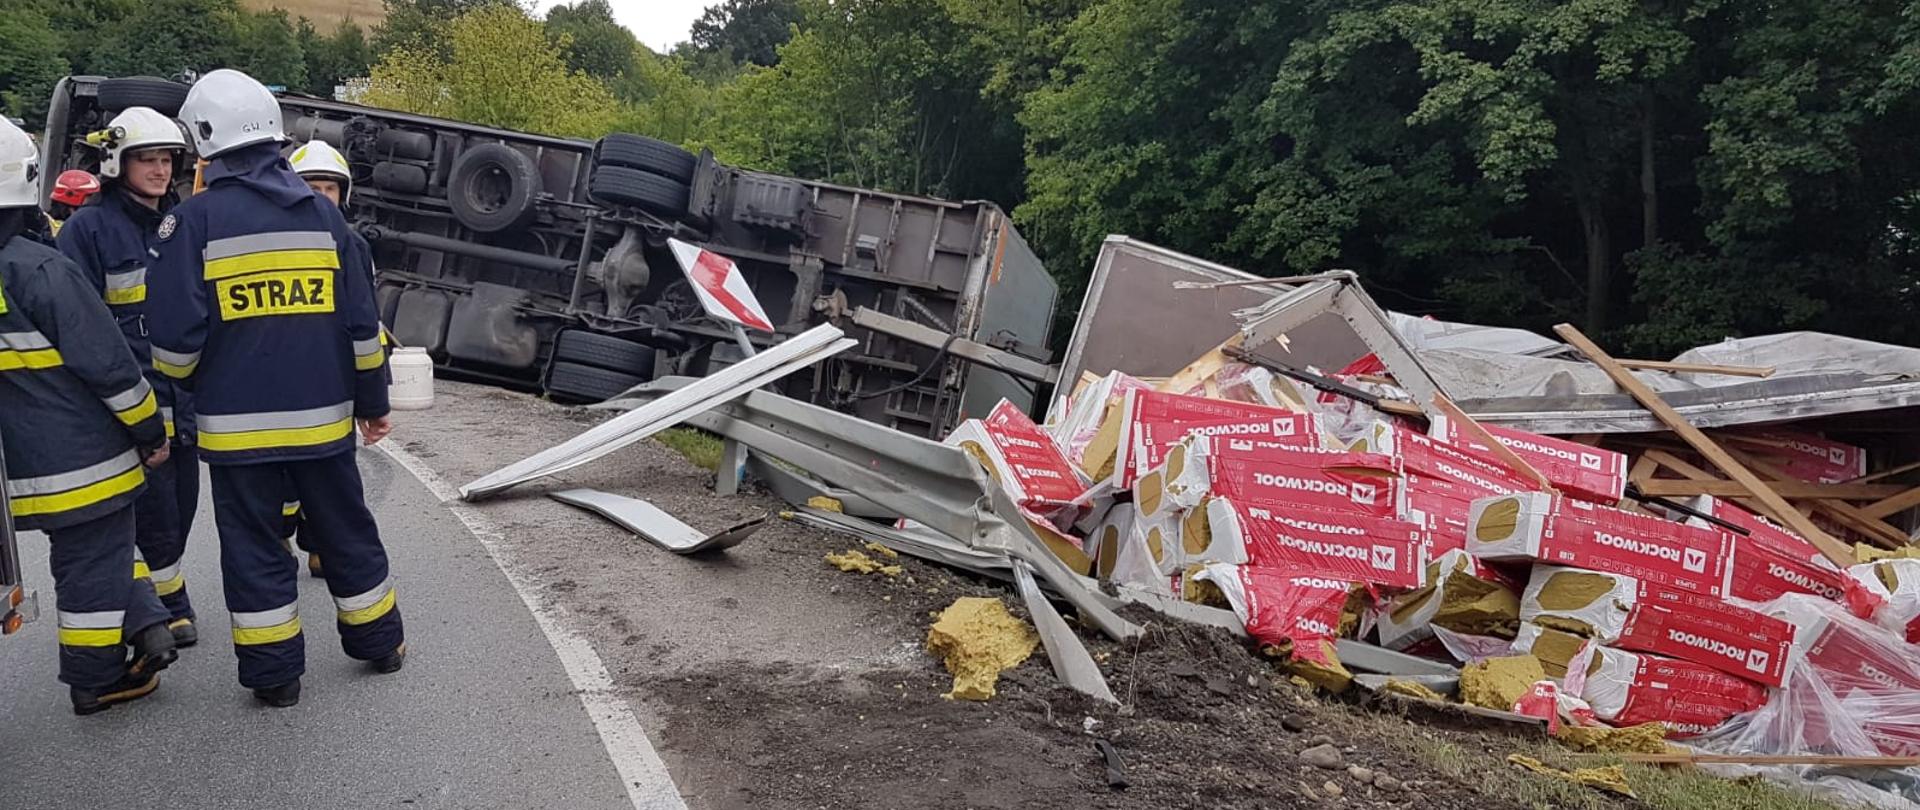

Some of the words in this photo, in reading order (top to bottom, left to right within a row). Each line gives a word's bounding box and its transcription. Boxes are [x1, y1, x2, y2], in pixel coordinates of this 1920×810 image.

[1253, 472, 1348, 496] ROCKWOOL
[1277, 533, 1368, 561] ROCKWOOL
[1593, 530, 1681, 562] ROCKWOOL
[1667, 628, 1746, 661] ROCKWOOL
